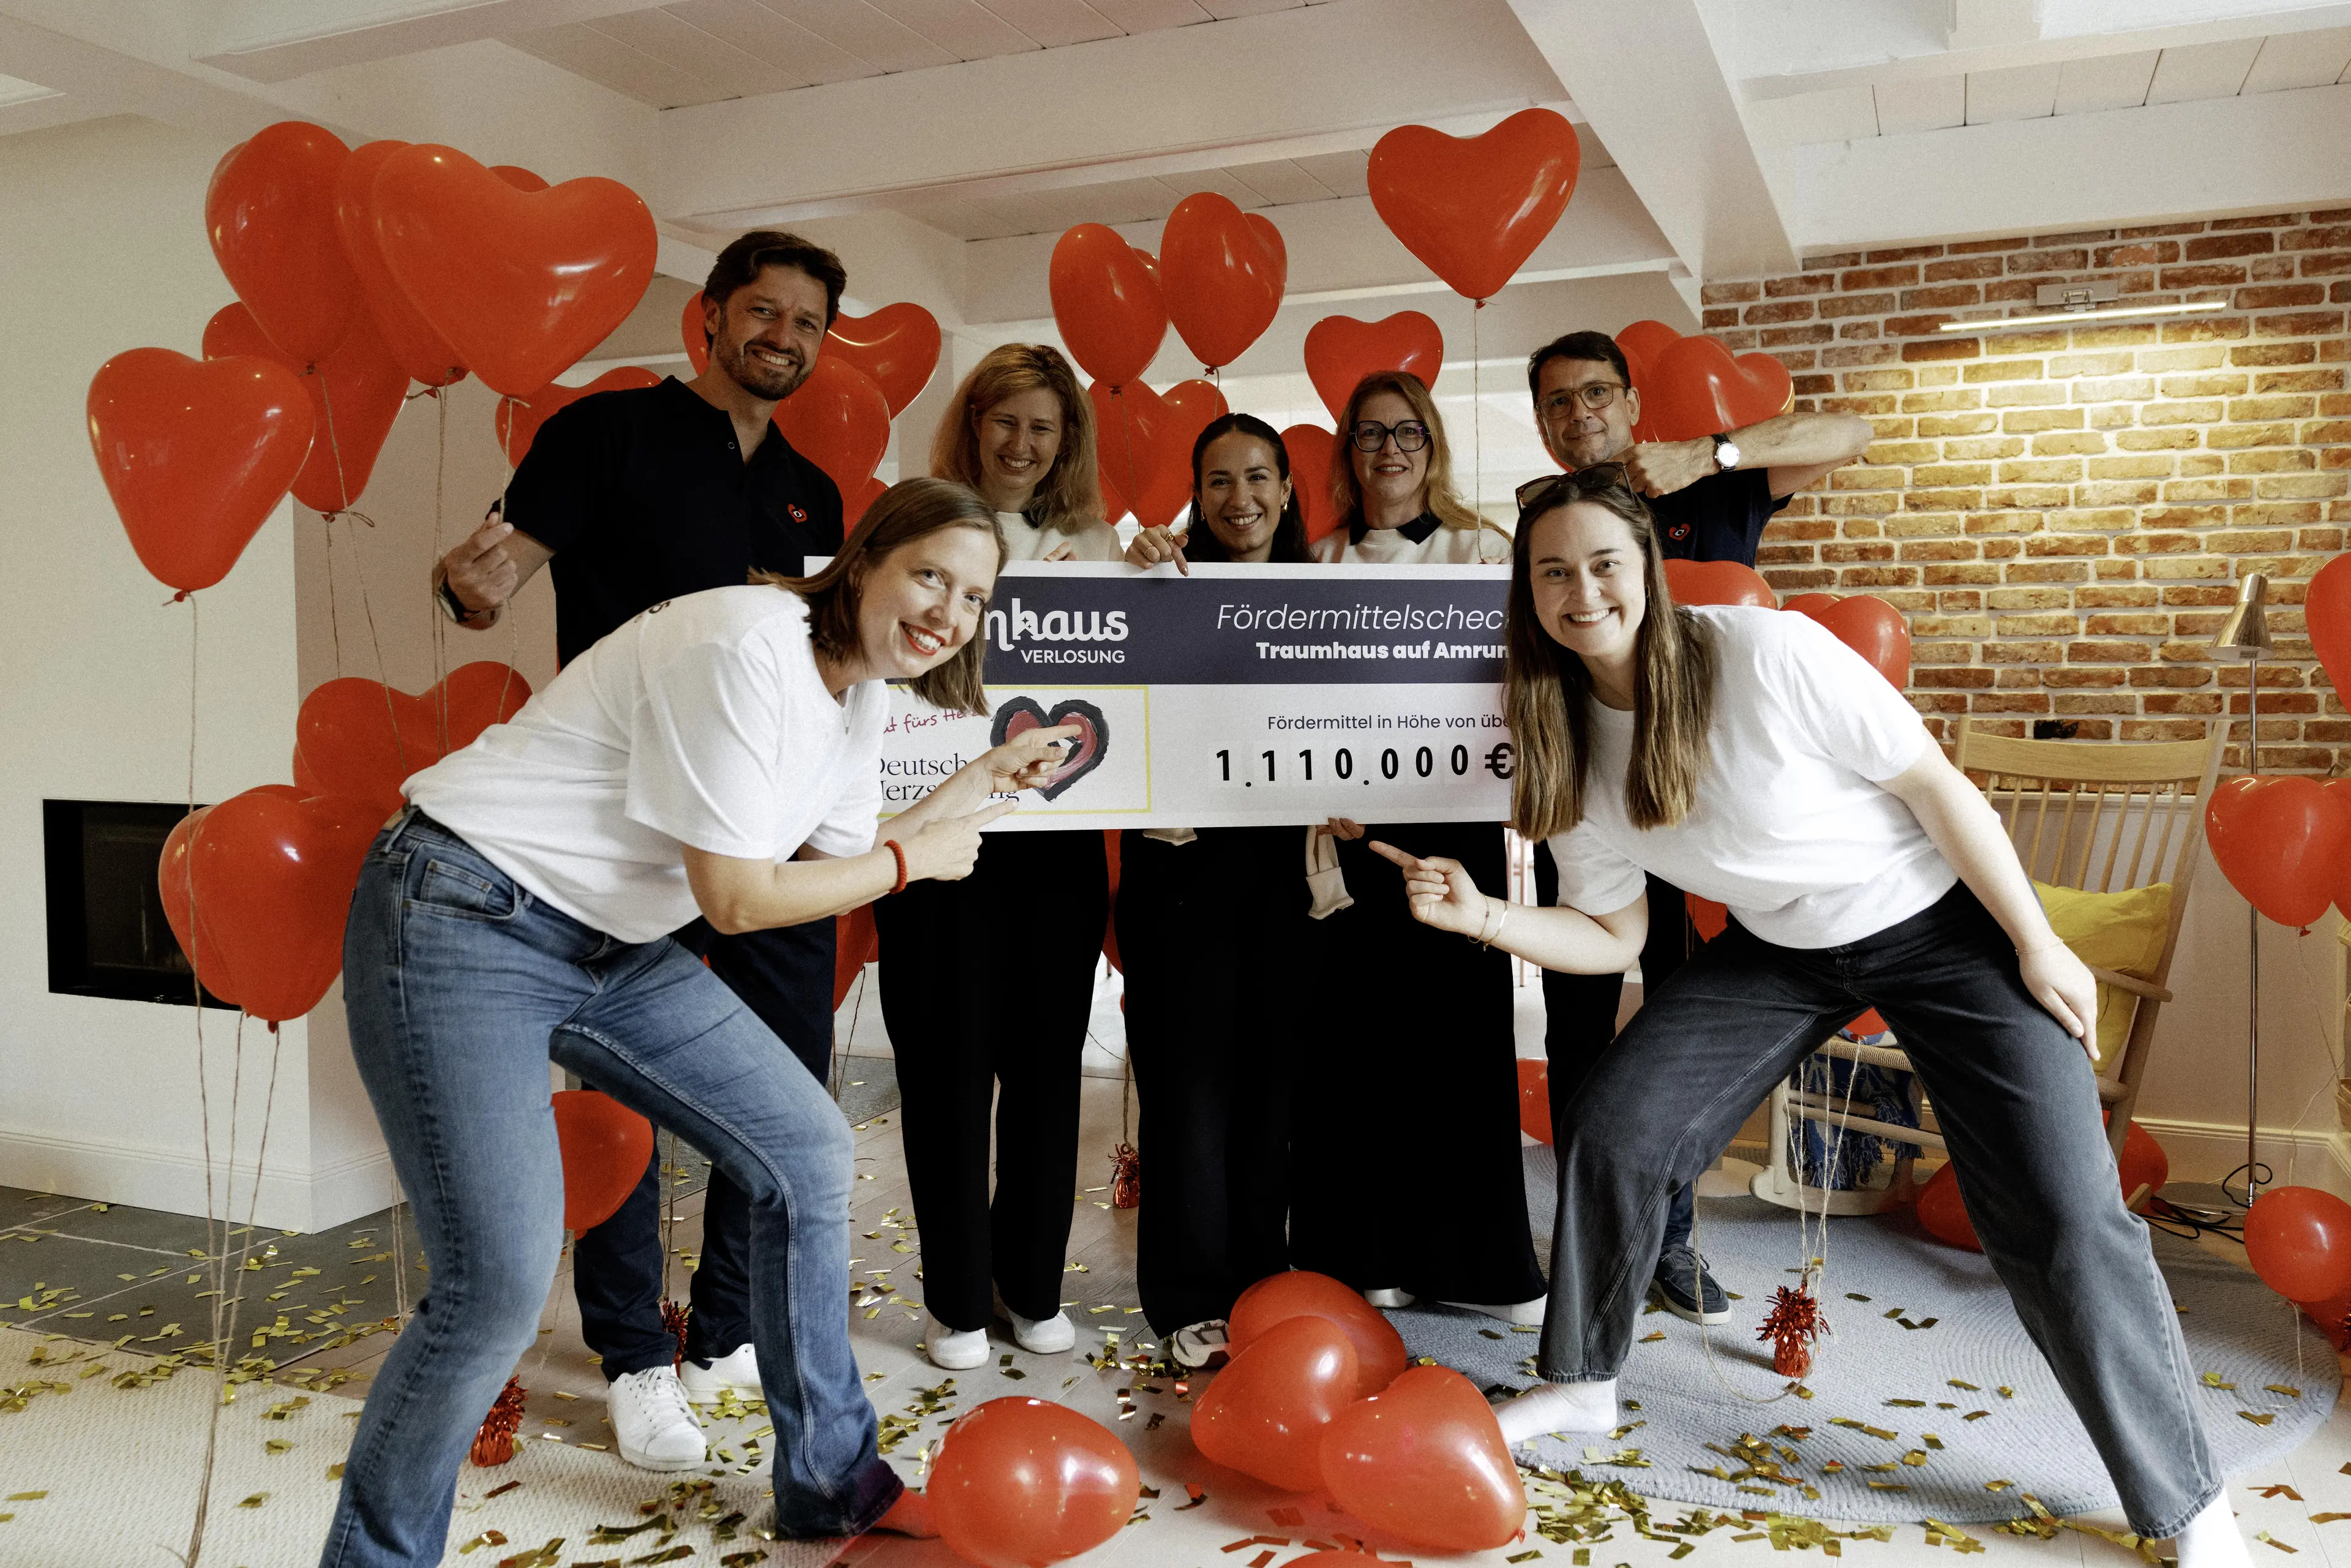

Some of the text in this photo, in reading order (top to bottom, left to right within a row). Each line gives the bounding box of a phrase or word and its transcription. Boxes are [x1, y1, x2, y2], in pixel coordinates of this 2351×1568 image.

[1217, 604, 1509, 630] Fördermittelschec
[1020, 650, 1125, 664] VERLOSUNG
[1256, 641, 1389, 659] Traumhaus
[1392, 640, 1430, 659] auf
[903, 713, 937, 733] fürs
[1268, 715, 1372, 730] Fördermittel
[1378, 715, 1392, 729] in
[1397, 715, 1441, 729] Höhe
[1445, 717, 1476, 729] von
[1484, 742, 1516, 780] €
